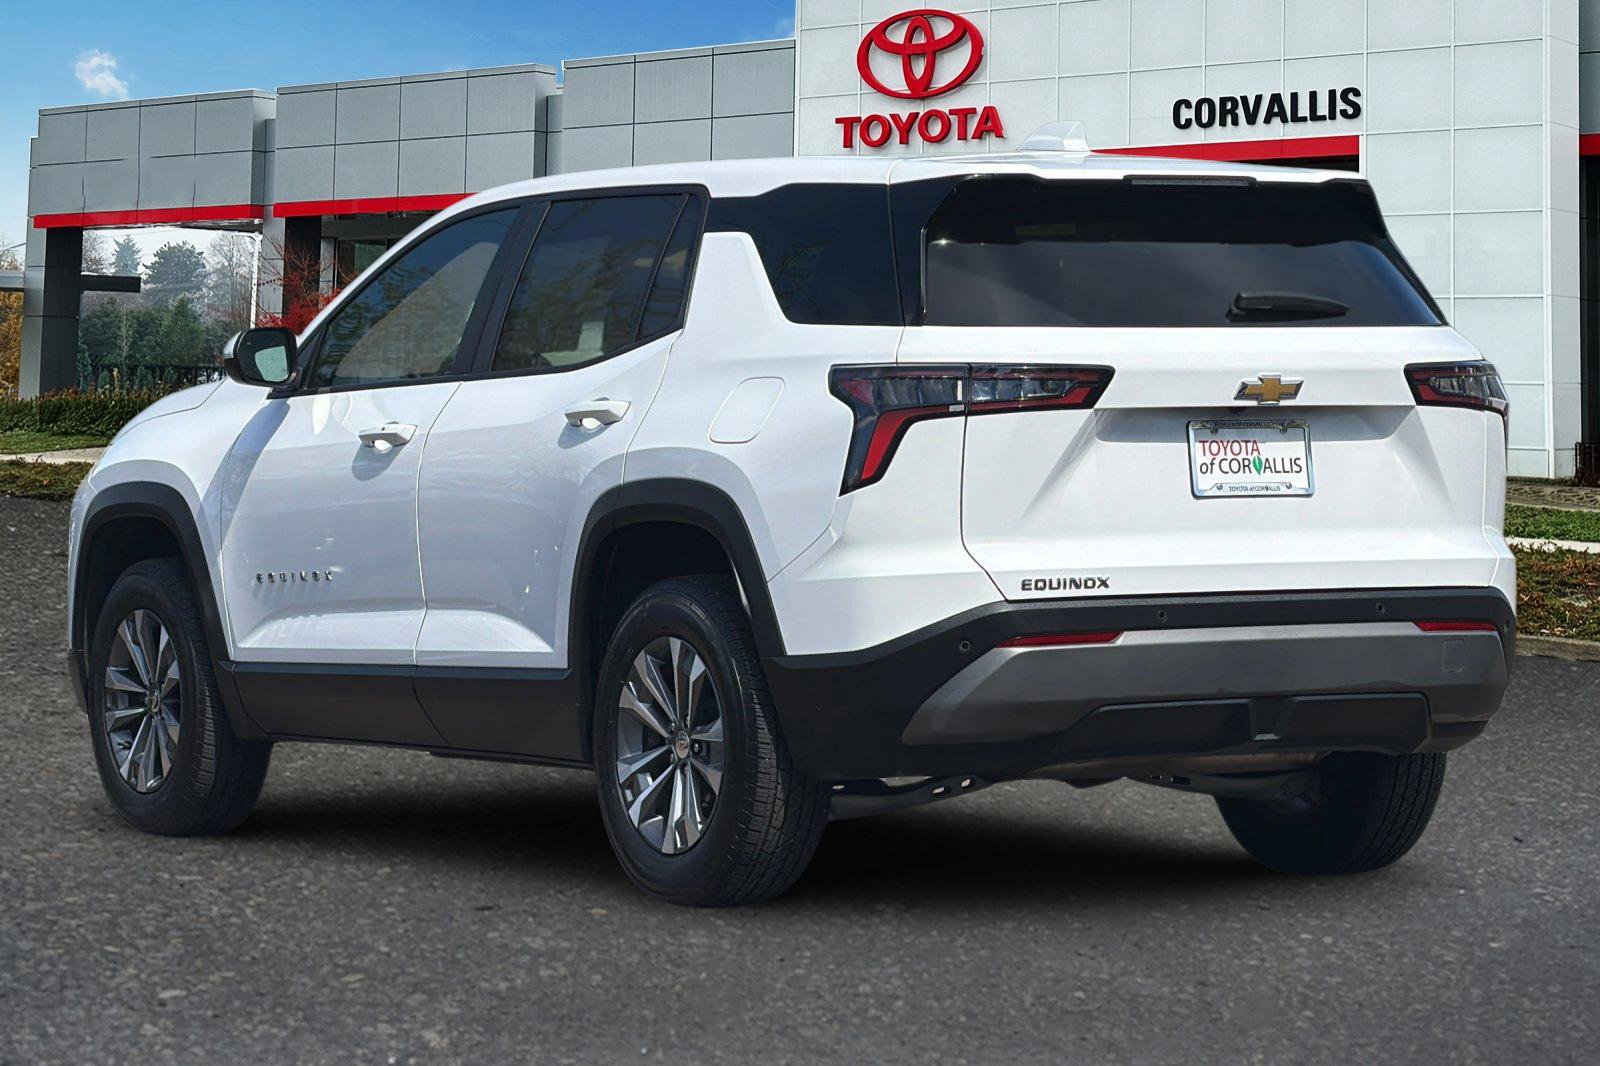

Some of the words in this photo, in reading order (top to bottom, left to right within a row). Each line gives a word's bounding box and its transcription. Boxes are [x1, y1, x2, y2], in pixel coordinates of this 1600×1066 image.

[1172, 86, 1362, 130] CORVALLIS
[835, 105, 1006, 149] TOYOTA
[1198, 439, 1261, 456] TOYOTA
[1199, 458, 1215, 475] of
[1229, 485, 1249, 493] TOYOTA
[256, 570, 333, 584] EQUINOX
[1021, 576, 1110, 591] EQUINOX
